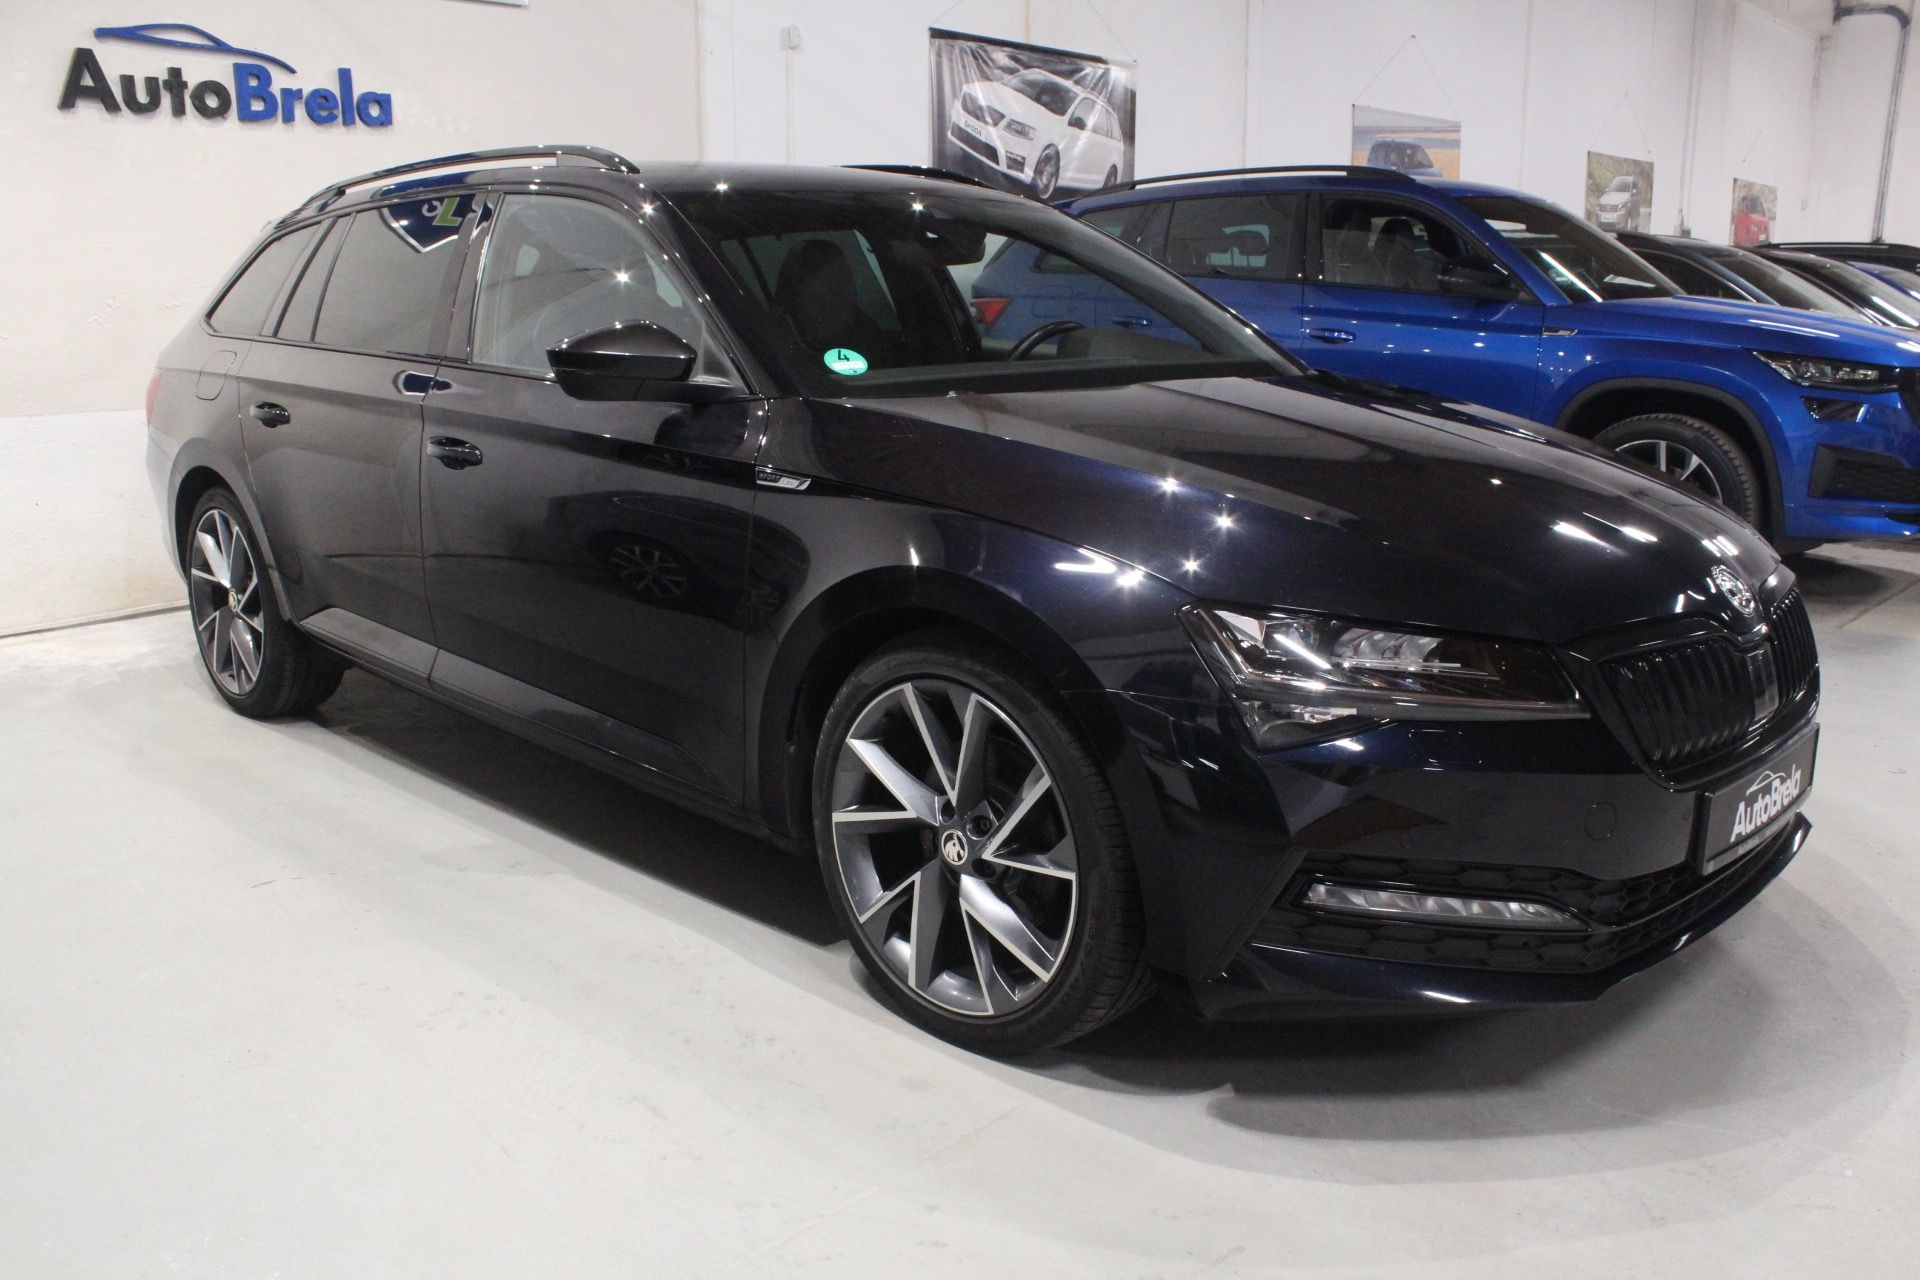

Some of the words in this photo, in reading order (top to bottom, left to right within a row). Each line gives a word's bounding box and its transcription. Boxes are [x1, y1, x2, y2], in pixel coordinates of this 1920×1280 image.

[57, 47, 393, 127] AutoBrela
[837, 349, 851, 362] 4
[1729, 763, 1802, 843] AutoBrela
